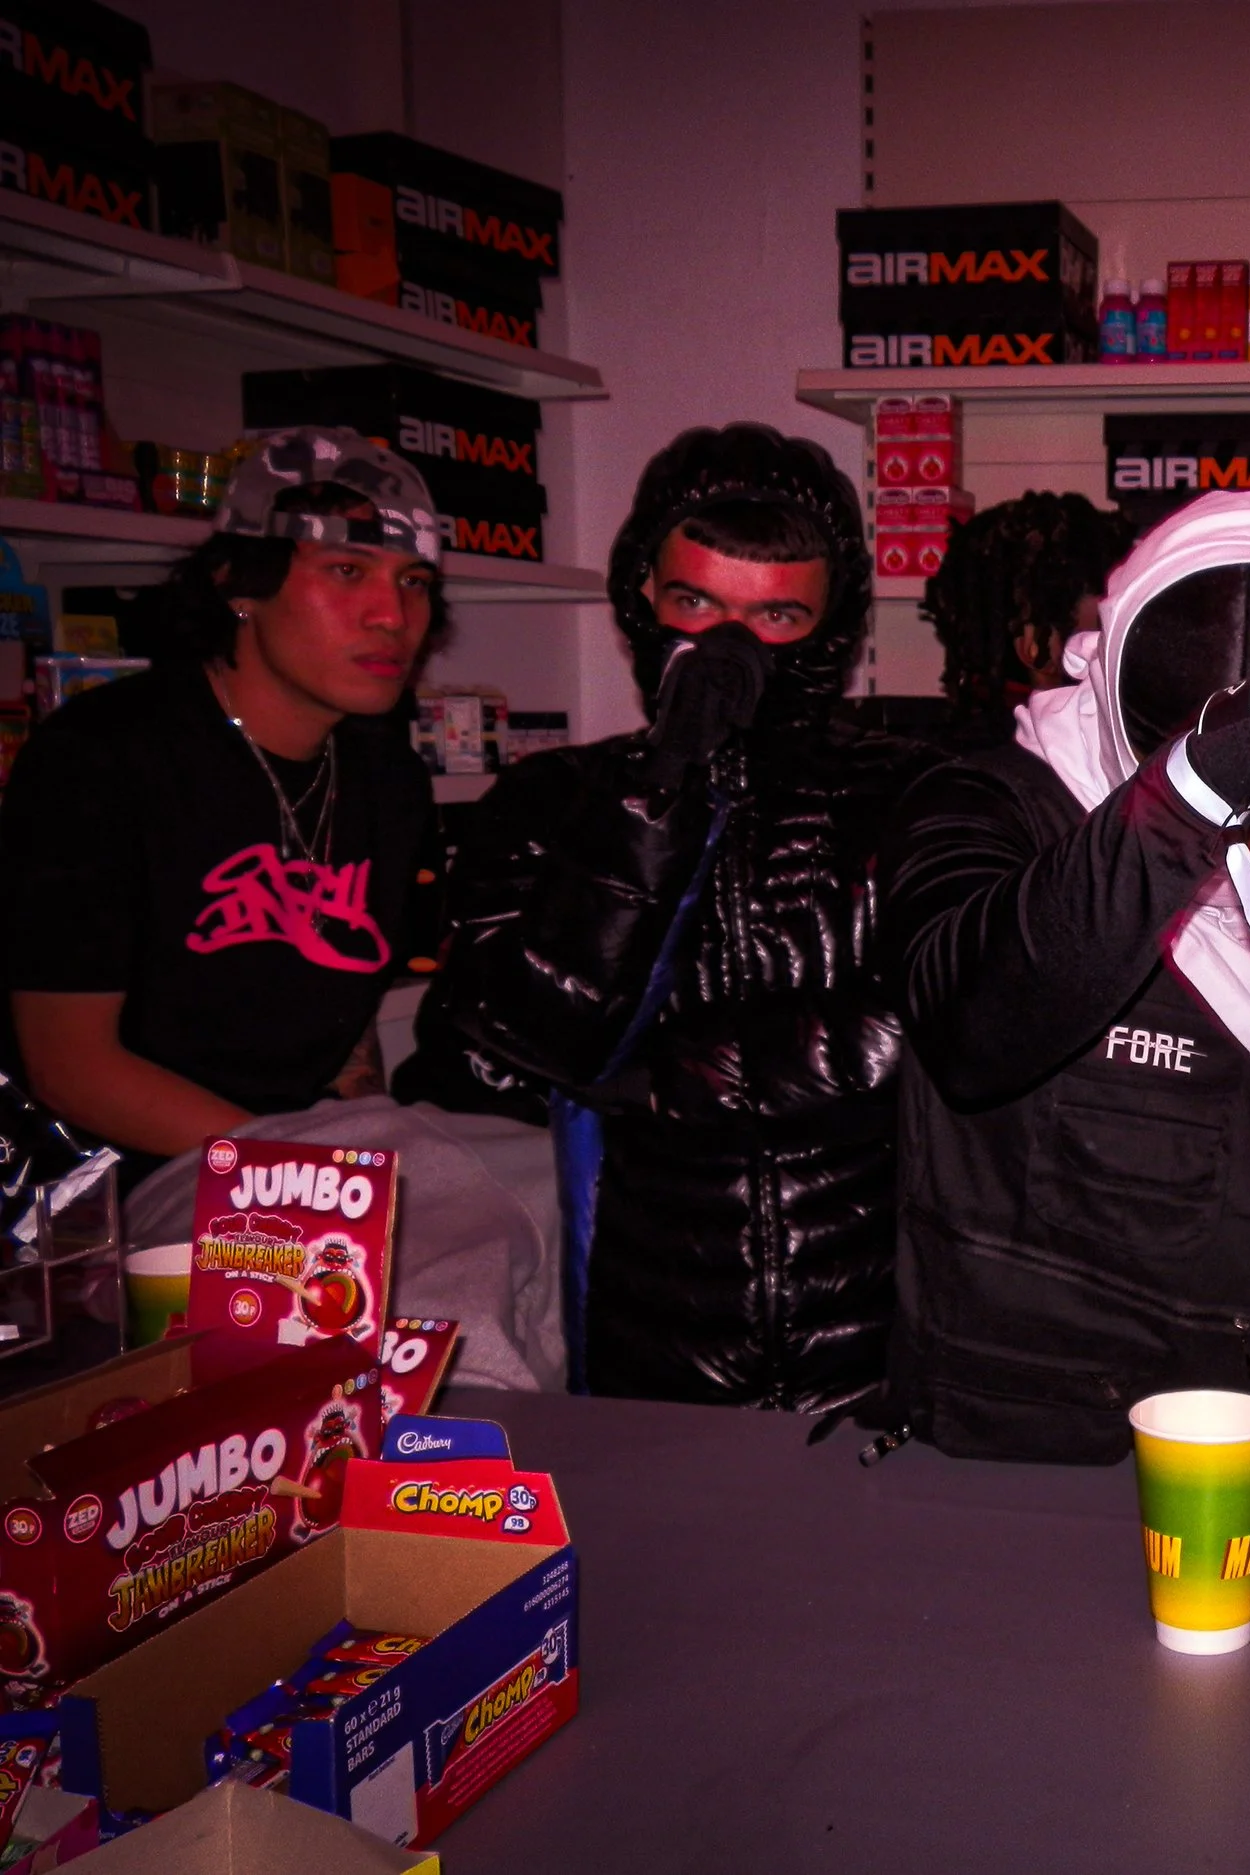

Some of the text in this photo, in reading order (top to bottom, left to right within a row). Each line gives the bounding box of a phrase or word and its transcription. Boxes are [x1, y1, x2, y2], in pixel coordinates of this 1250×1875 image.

[1106, 1025, 1196, 1074] FORE
[230, 1161, 373, 1219] JUMBO
[196, 1238, 305, 1279] JAWBREAKER
[250, 1271, 276, 1283] STICK
[397, 1432, 452, 1455] Cadbury
[106, 1428, 287, 1550] JUMBO
[511, 1517, 525, 1527] 98
[108, 1504, 277, 1632] JAWBREAKER
[197, 1571, 233, 1598] STICK
[344, 1717, 359, 1736] 60
[360, 1712, 367, 1723] x
[380, 1694, 393, 1709] 21
[394, 1685, 401, 1700] g
[346, 1702, 401, 1755] STANDARD
[348, 1741, 375, 1773] BARS
